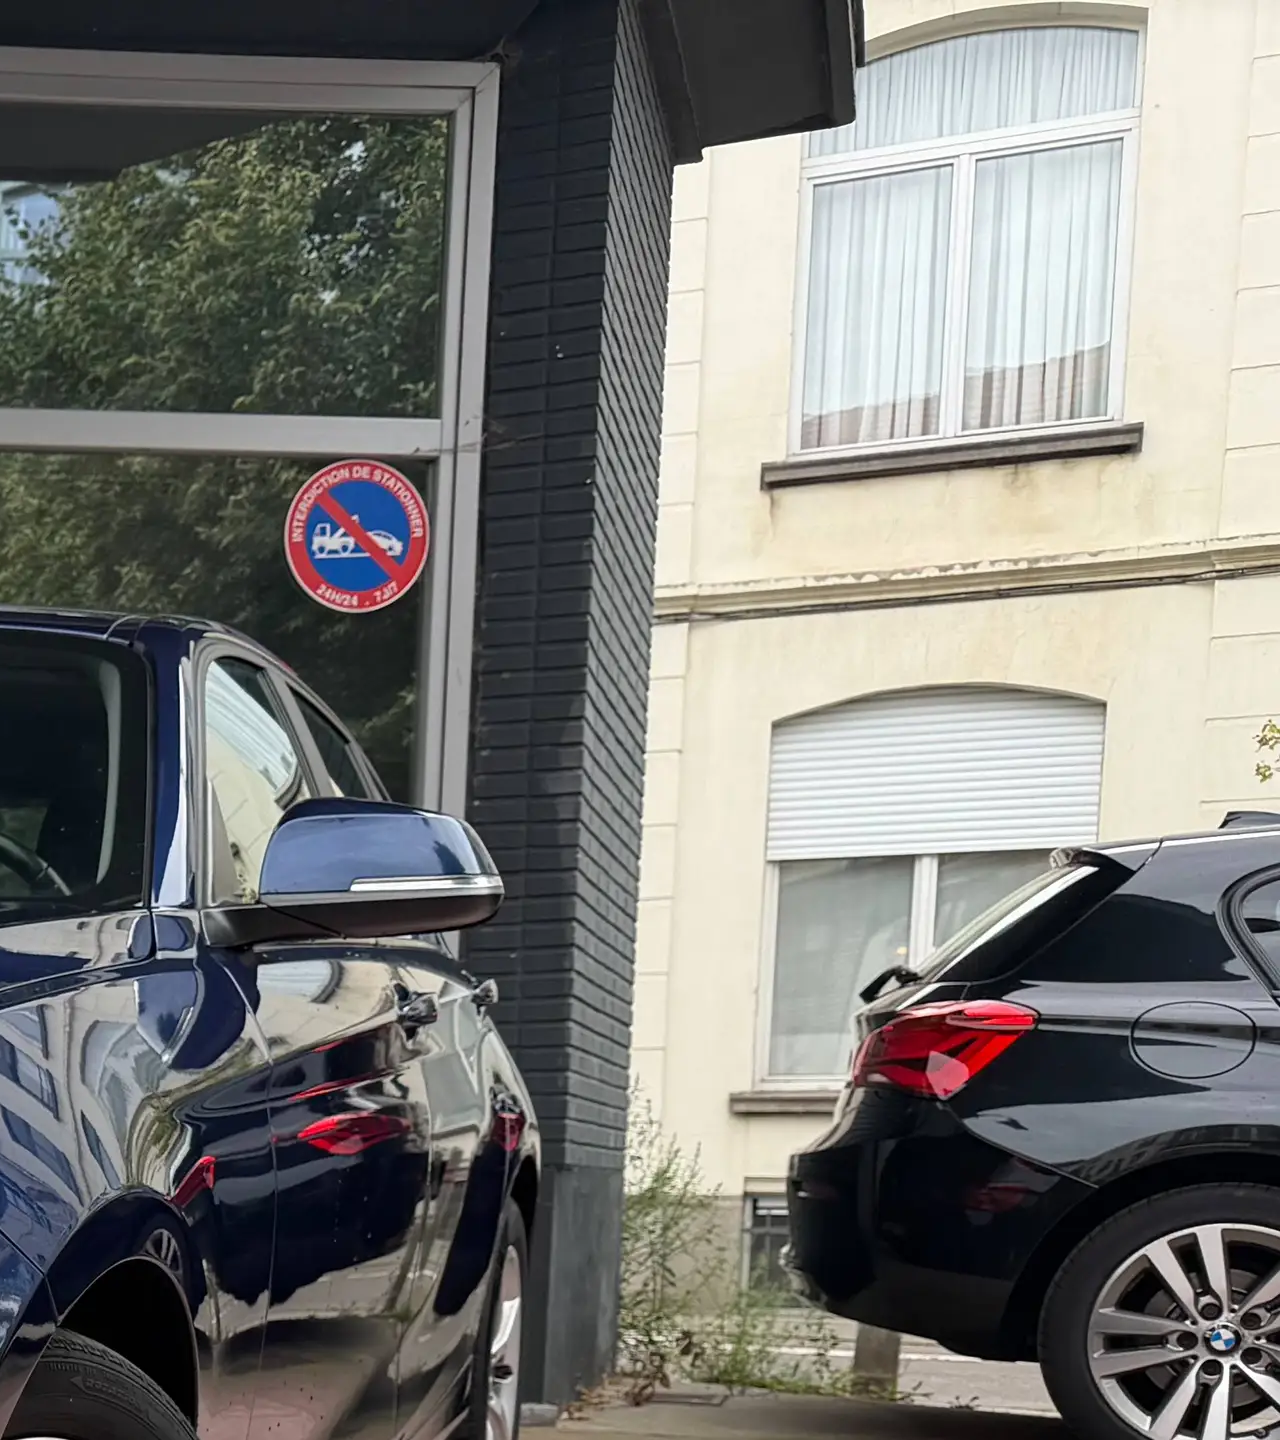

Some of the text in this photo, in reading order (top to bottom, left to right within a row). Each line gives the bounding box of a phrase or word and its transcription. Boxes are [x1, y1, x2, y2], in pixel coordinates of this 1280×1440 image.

[291, 466, 424, 543] INTERDICTION DE STATIONNER
[315, 583, 359, 607] 24H/24
